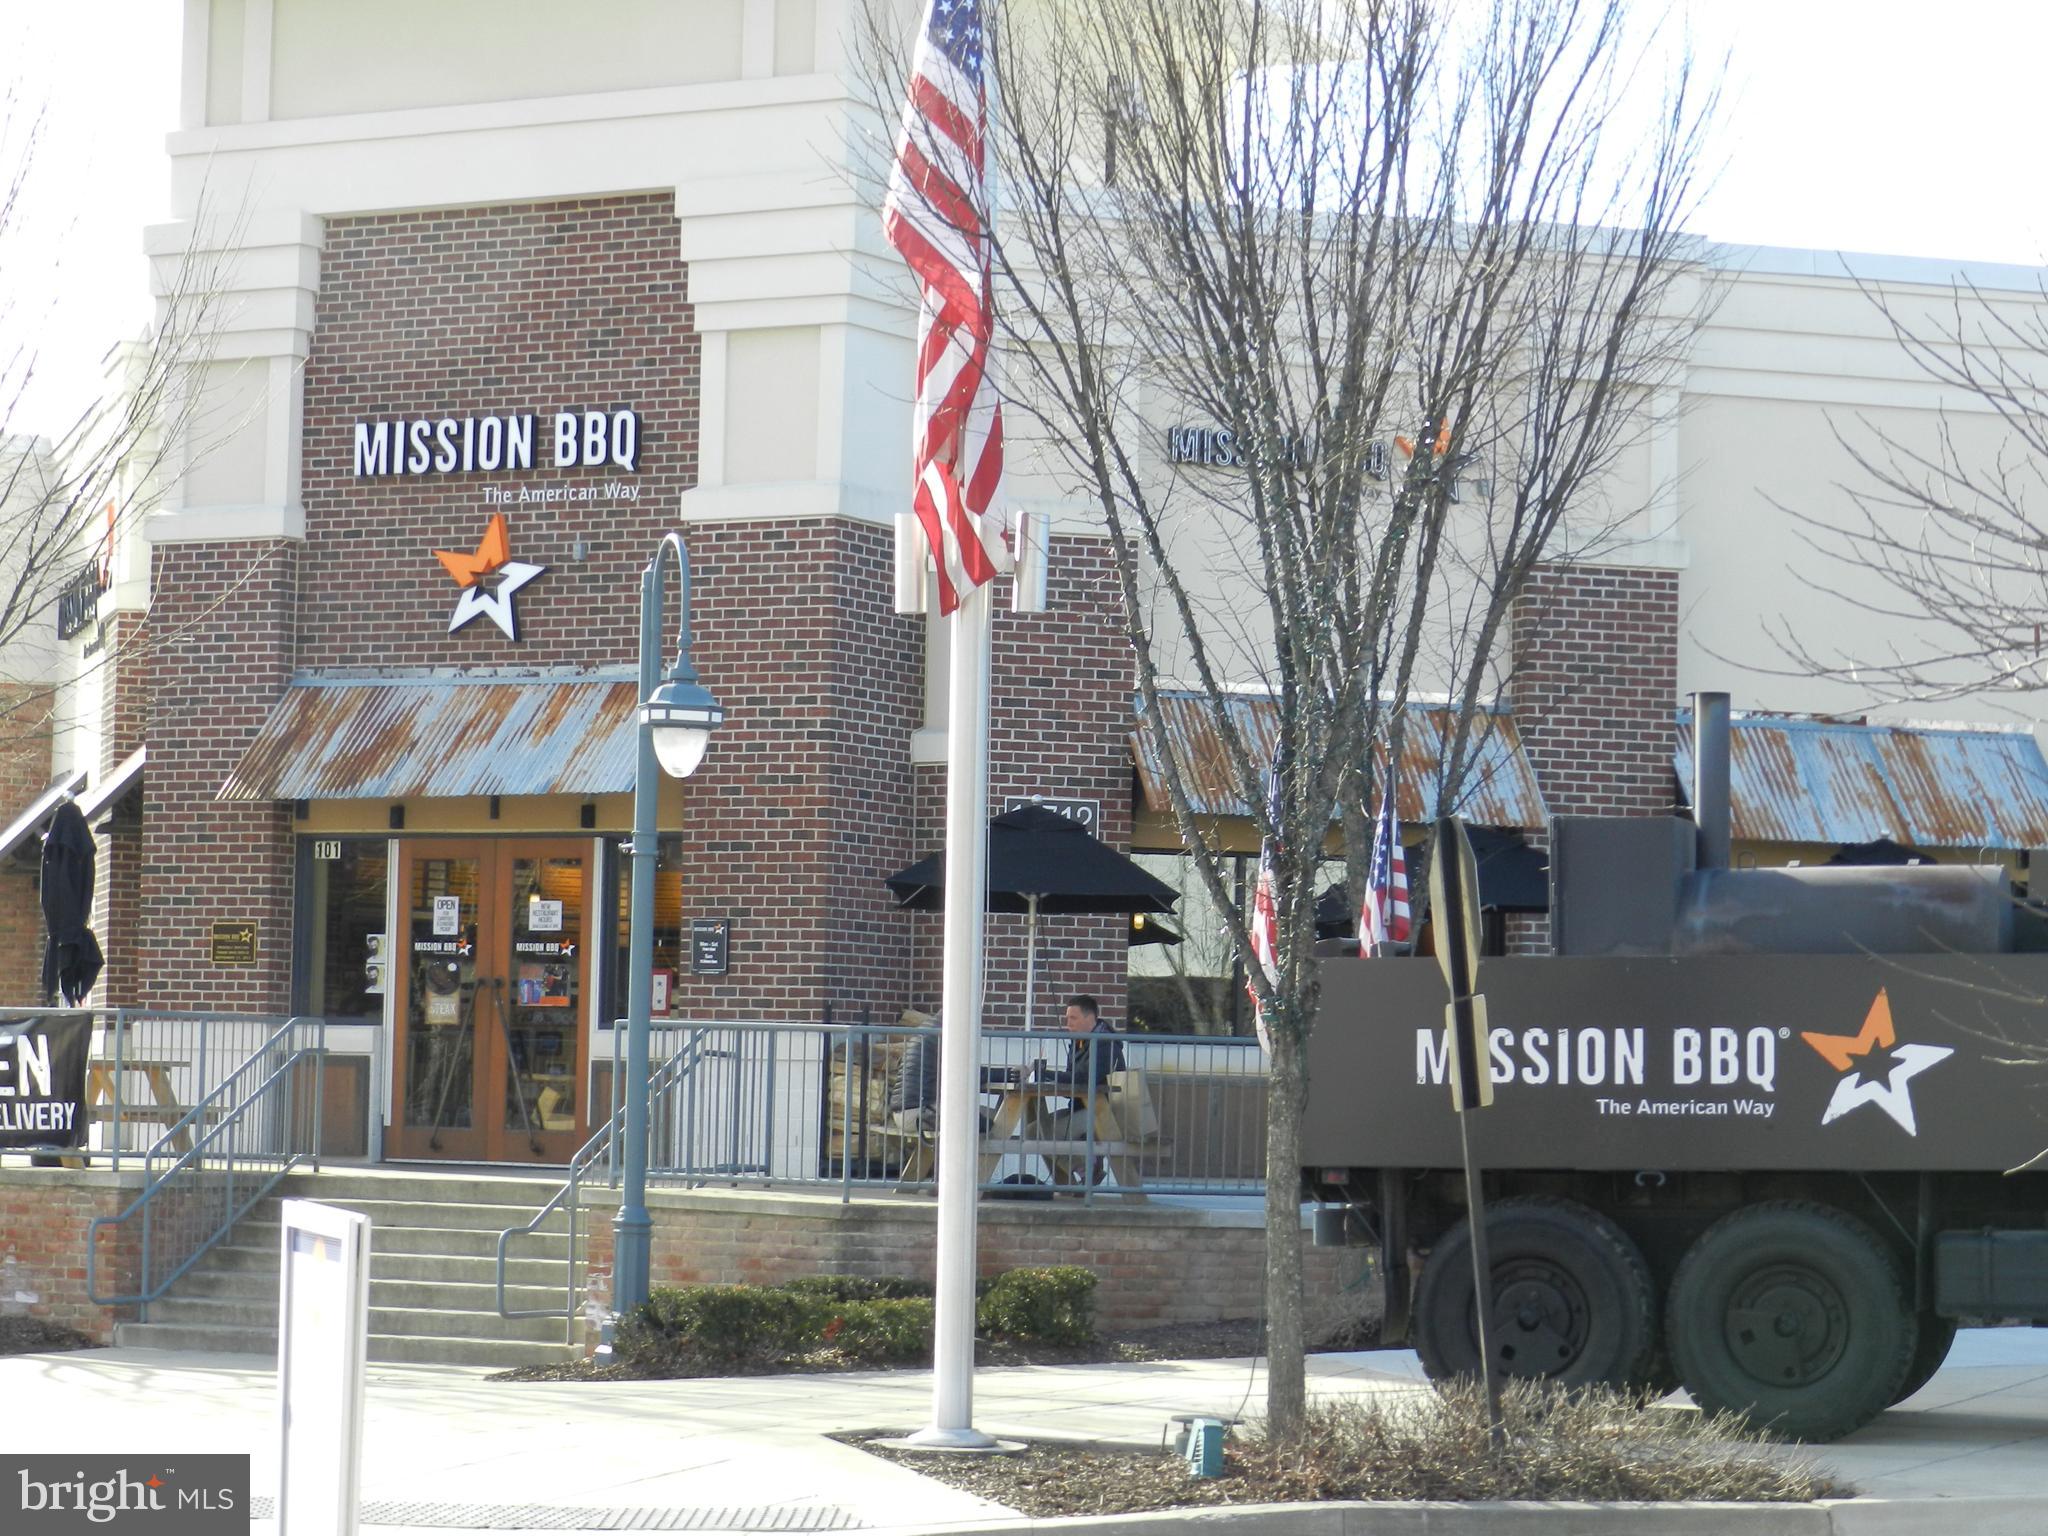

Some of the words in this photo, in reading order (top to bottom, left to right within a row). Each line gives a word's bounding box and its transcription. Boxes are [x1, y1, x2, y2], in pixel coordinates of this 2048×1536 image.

[354, 414, 534, 477] MISSION
[554, 410, 638, 472] BBQ
[482, 487, 512, 504] The
[518, 485, 598, 502] American
[317, 842, 340, 858] 101
[437, 899, 456, 911] OPEN
[516, 942, 545, 952] MISSION
[1416, 1028, 1644, 1085] MSSION
[0, 1102, 76, 1130] LIVERY
[1596, 1099, 1631, 1115] The
[1637, 1099, 1728, 1115] American
[1733, 1099, 1775, 1118] Way
